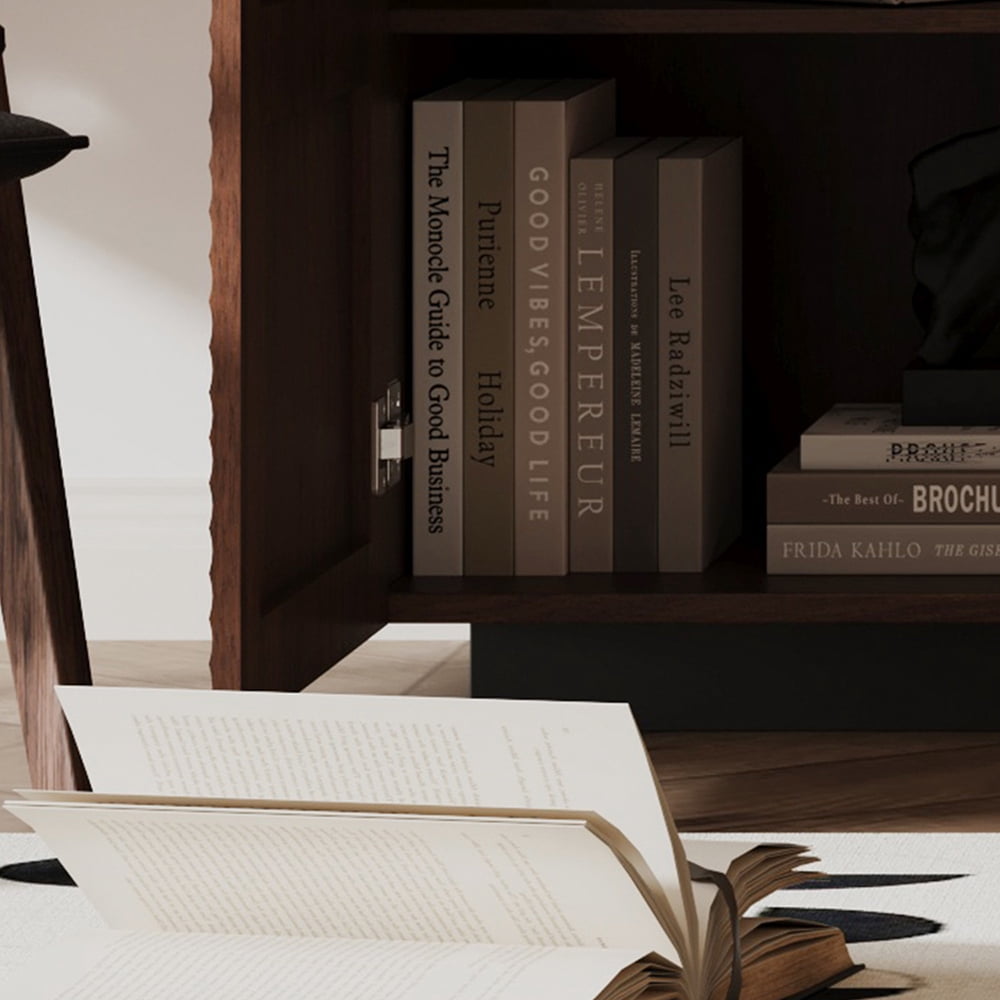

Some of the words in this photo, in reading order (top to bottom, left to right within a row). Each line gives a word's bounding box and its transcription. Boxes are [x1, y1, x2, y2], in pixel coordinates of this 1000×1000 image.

[428, 147, 449, 187] The
[529, 167, 549, 251] GOOD
[578, 182, 587, 234] OLIVIER
[428, 195, 449, 283] Monocle
[478, 201, 501, 309] Purienne
[429, 289, 450, 350] Guide
[669, 278, 690, 318] Lee
[429, 359, 444, 377] to
[578, 249, 603, 516] LEMPEREUR
[669, 331, 691, 447] Radziwill
[429, 384, 450, 440] Good
[471, 372, 504, 467] Holiday
[530, 361, 549, 445] GOOD
[428, 448, 449, 534] Business
[529, 460, 549, 520] LIFE
[855, 494, 879, 504] Best
[784, 541, 842, 558] FRIDA
[852, 542, 921, 558] KAHLO
[935, 544, 964, 556] THE
